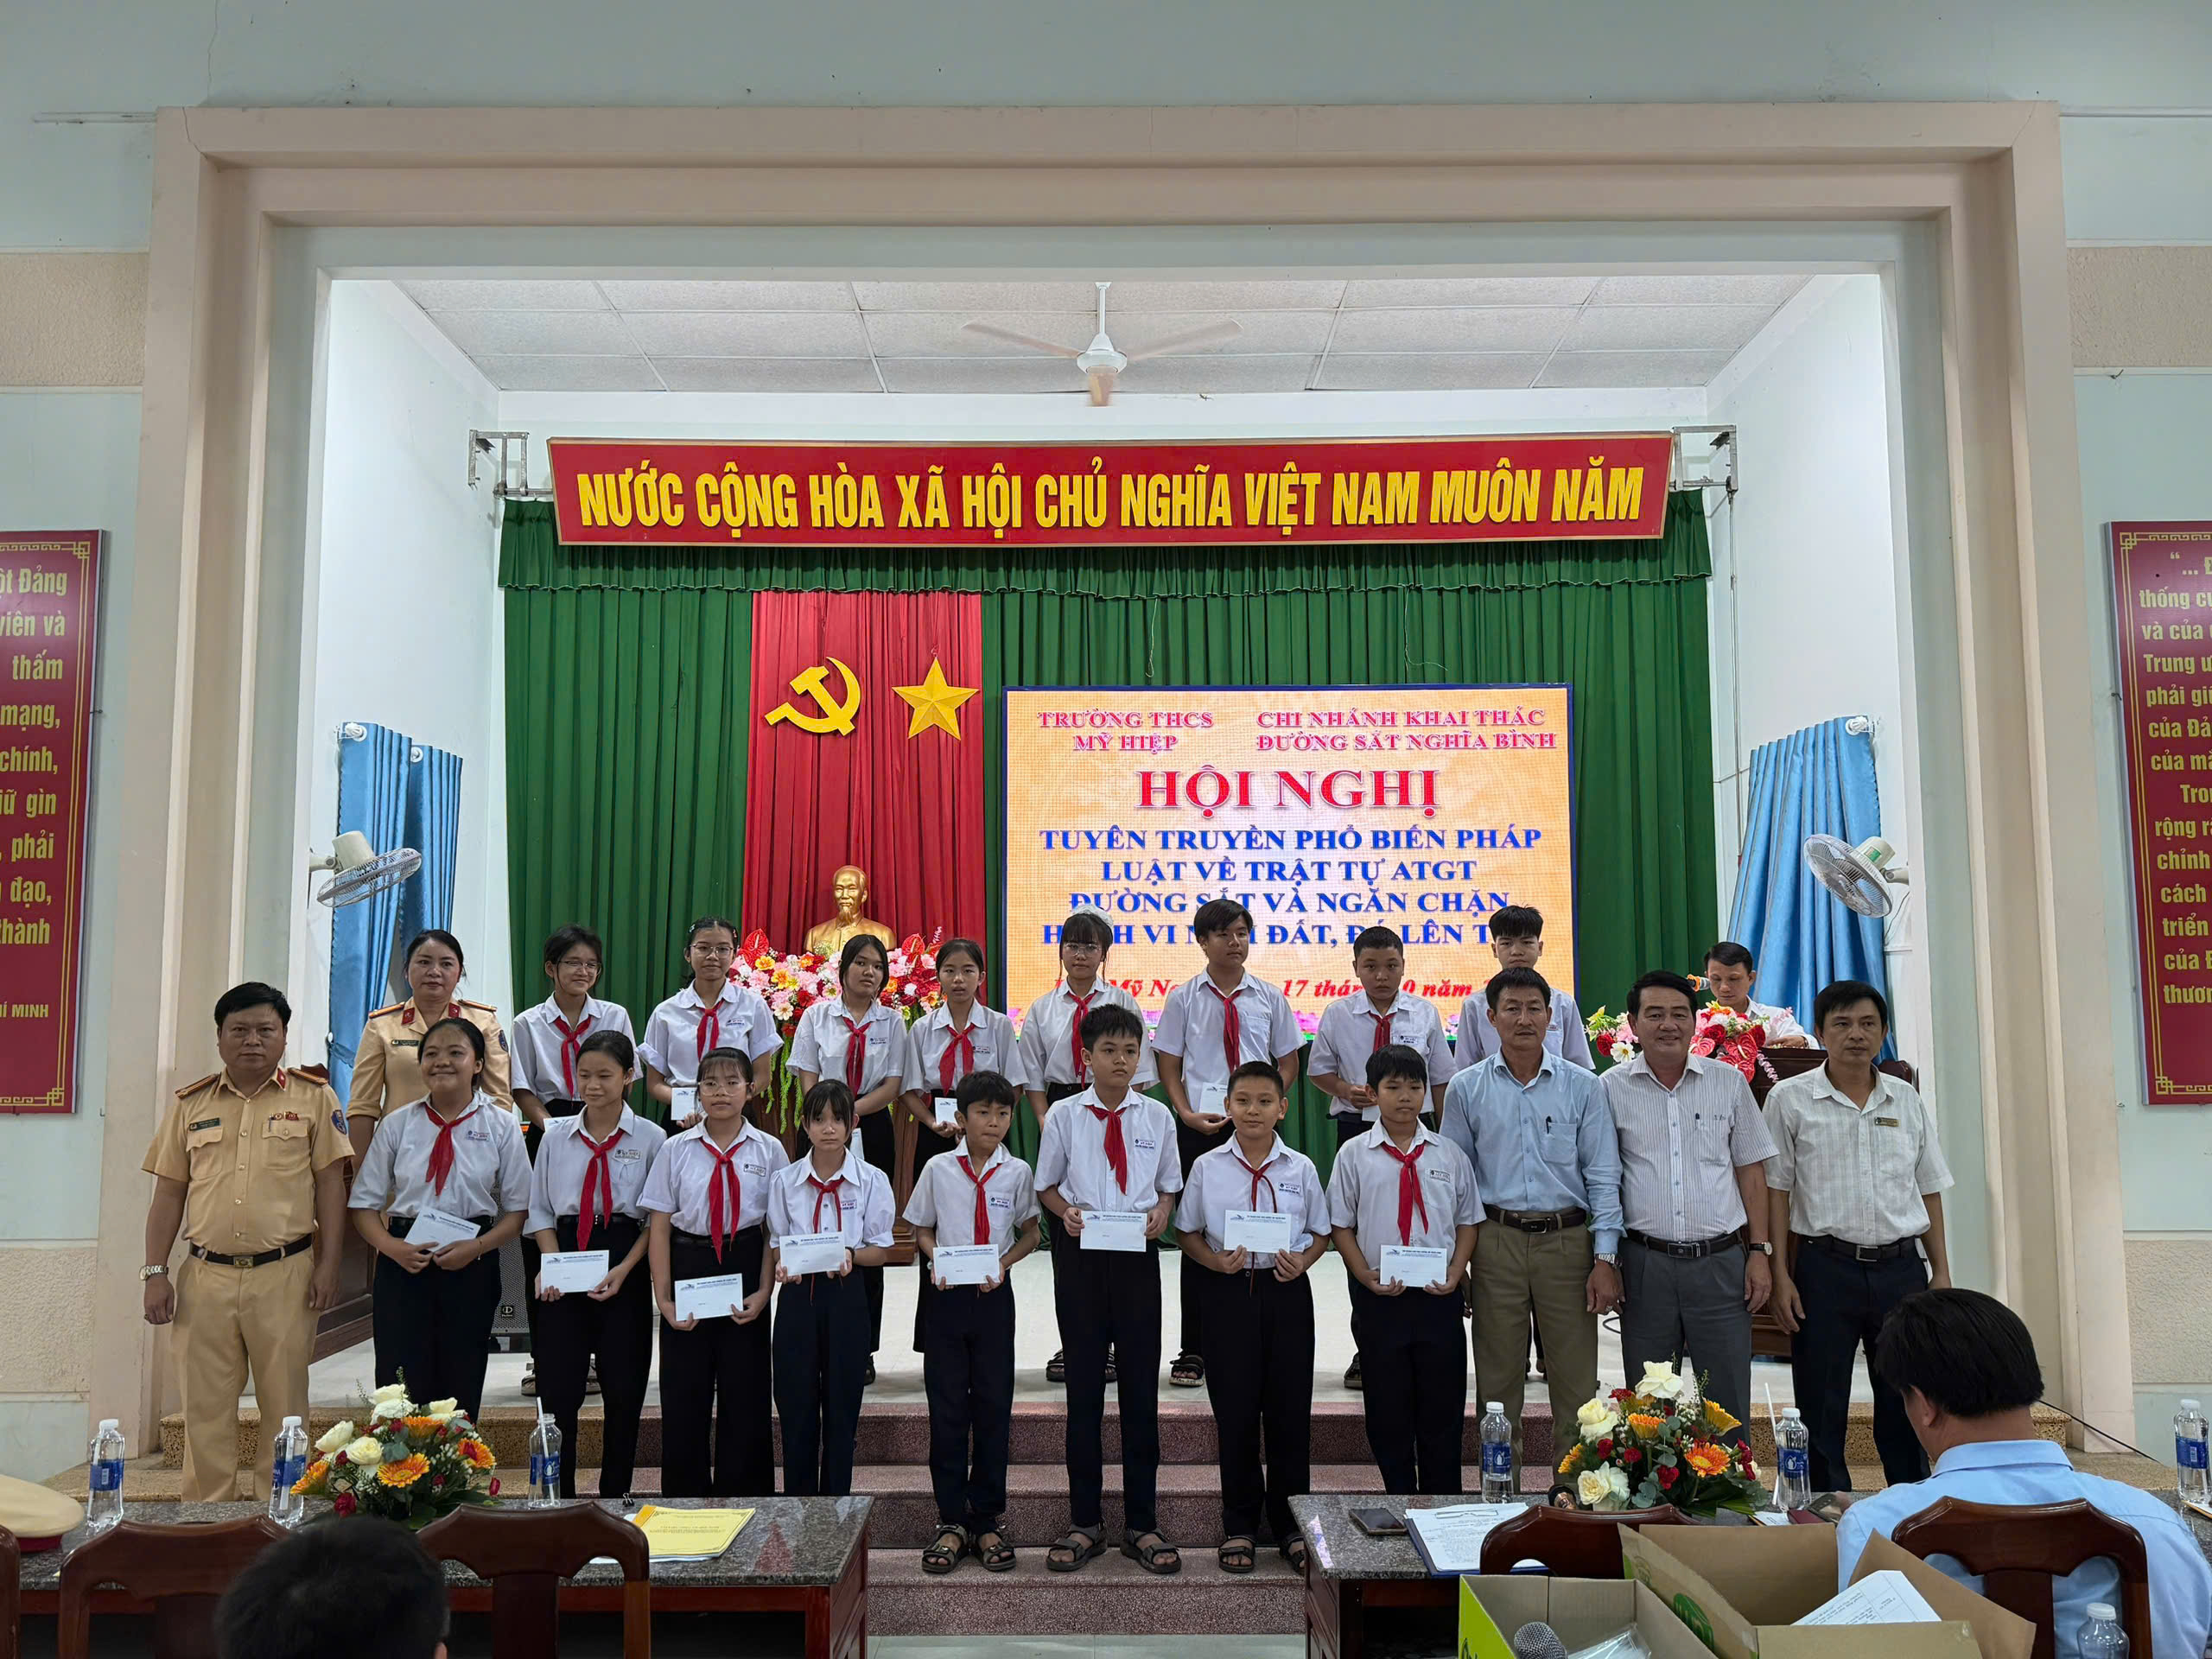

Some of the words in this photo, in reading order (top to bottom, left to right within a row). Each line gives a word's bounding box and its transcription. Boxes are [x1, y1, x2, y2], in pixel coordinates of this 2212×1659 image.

[577, 460, 683, 527] NƯỚC
[697, 461, 797, 537] CỘNG
[809, 461, 884, 527] HÒA
[896, 466, 950, 528] XÃ
[963, 461, 1021, 537] HỘI
[1036, 456, 1107, 527] CHỦ
[1121, 463, 1231, 527] NGHĨA
[1244, 461, 1319, 534] VIỆT
[1332, 471, 1420, 525] NAM
[1430, 457, 1541, 523] MUÔN
[1552, 457, 1643, 520] NĂM
[19, 564, 67, 596] Đảng
[2139, 586, 2190, 610] thống
[43, 610, 65, 636] và
[2142, 620, 2163, 639] và
[2170, 619, 2202, 639] của
[12, 649, 62, 680] thấm
[2143, 654, 2195, 674] Trung
[2146, 683, 2184, 708] phải
[0, 704, 60, 731] mạng,
[1038, 709, 1142, 728] TRƯỜNG
[1149, 711, 1214, 728] THCS
[1256, 711, 1302, 727] CHI
[1307, 708, 1397, 727] NHÁNH
[1404, 709, 1469, 727] KHAI
[1474, 706, 1545, 726] THÁC
[2148, 716, 2182, 738] của
[1073, 732, 1112, 751] MỸ
[1119, 733, 1178, 754] HIỆP
[1256, 731, 1348, 751] ĐƯỜNG
[1405, 729, 1488, 750] NGHĨA
[1493, 728, 1557, 749] BÌNH
[0, 746, 58, 774] chính,
[2151, 749, 2184, 771] của
[26, 788, 56, 817] gìn
[1135, 764, 1255, 818] HỘI
[1274, 770, 1442, 817] NGHỊ
[1039, 825, 1146, 850] TUYÊN
[1155, 824, 1285, 850] TRUYỀN
[1295, 823, 1363, 850] PHỔ
[1370, 823, 1446, 849] BIẾN
[1456, 823, 1542, 849] PHÁP
[2155, 817, 2196, 841] rộng
[11, 830, 54, 862] phải
[1101, 858, 1188, 887] LUẬT
[1194, 855, 1237, 881] VỀ
[1244, 858, 1332, 887] TRẬT
[1338, 858, 1386, 886] TỰ
[1392, 861, 1477, 881] ATGT
[2157, 848, 2210, 870] chỉnh
[10, 876, 52, 908] đạo,
[1069, 887, 1187, 913] ĐƯỜNG
[1262, 887, 1308, 912] VÀ
[1316, 887, 1408, 912] NGĂN
[1417, 888, 1510, 918] CHẶN
[2161, 883, 2207, 904] cách
[0, 918, 50, 944] hành
[1143, 925, 1176, 944] VI
[1266, 918, 1338, 949] ĐẤT,
[1400, 918, 1464, 944] LÊN
[2163, 912, 2209, 937] triển
[2164, 948, 2200, 970] của
[1283, 979, 1309, 997] 17
[1422, 979, 1472, 996] năm
[11, 1004, 49, 1018] MINH
